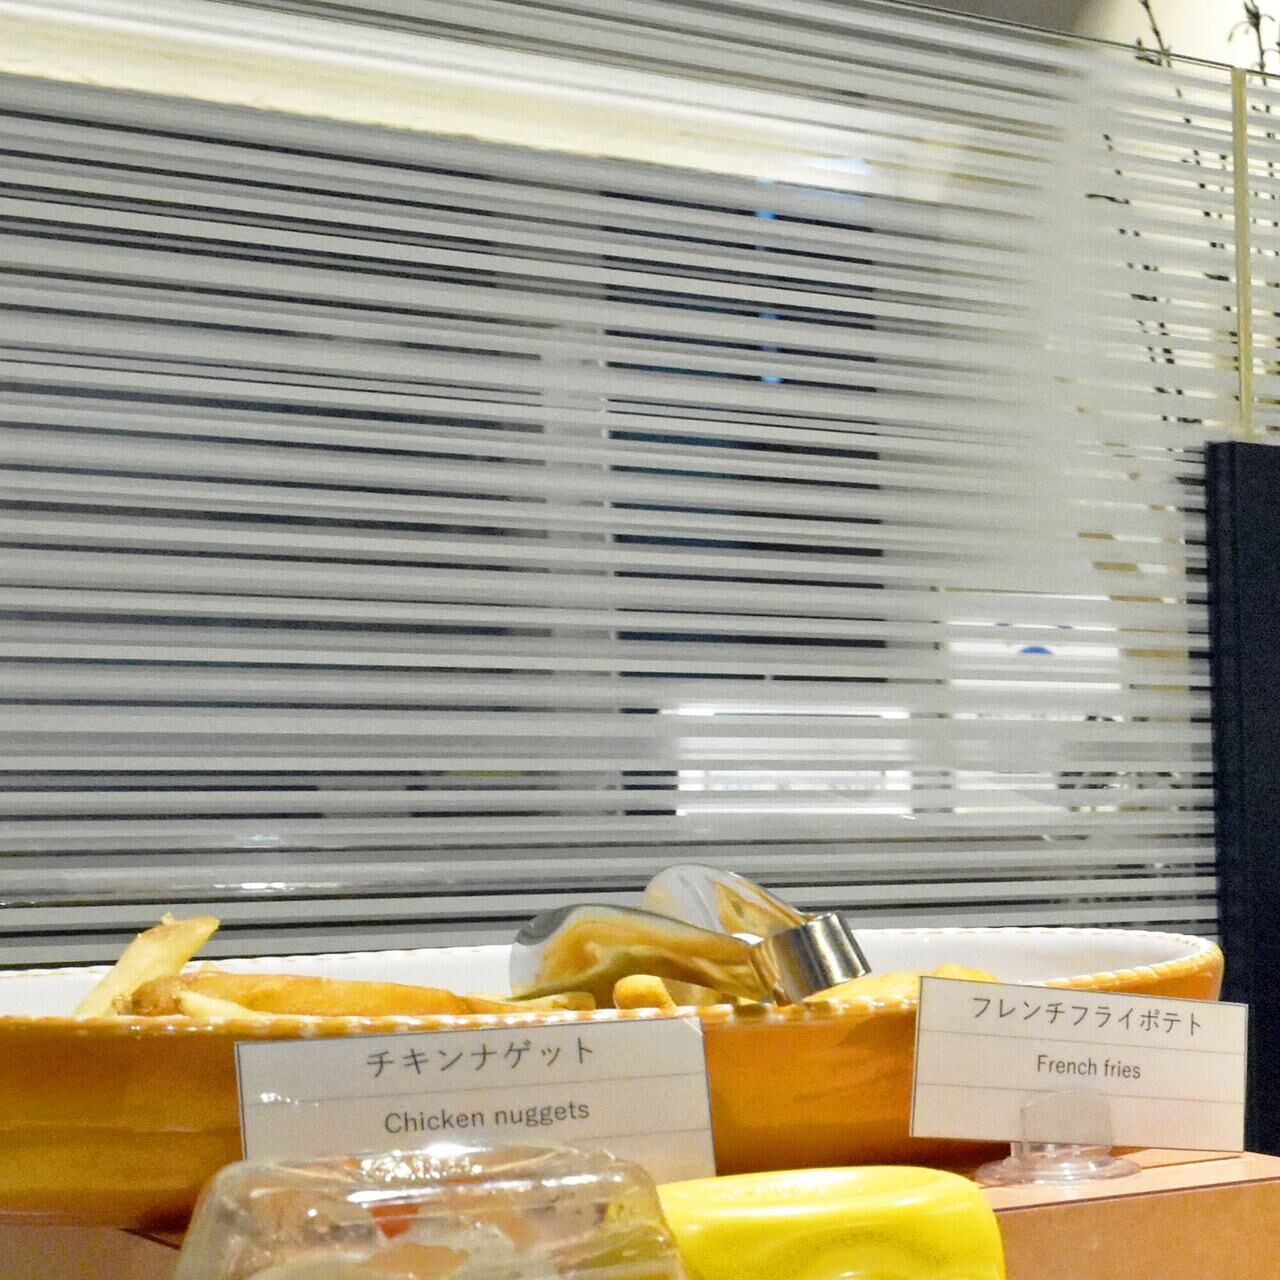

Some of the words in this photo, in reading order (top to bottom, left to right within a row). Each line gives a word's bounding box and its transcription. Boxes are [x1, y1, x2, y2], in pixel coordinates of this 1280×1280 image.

[973, 996, 1201, 1036] フレンチフライポテト
[367, 1037, 593, 1078] チキンナゲット
[1036, 1054, 1097, 1076] French
[1103, 1059, 1141, 1079] fries
[384, 1109, 485, 1134] Chicken
[494, 1101, 590, 1127] nuggets
